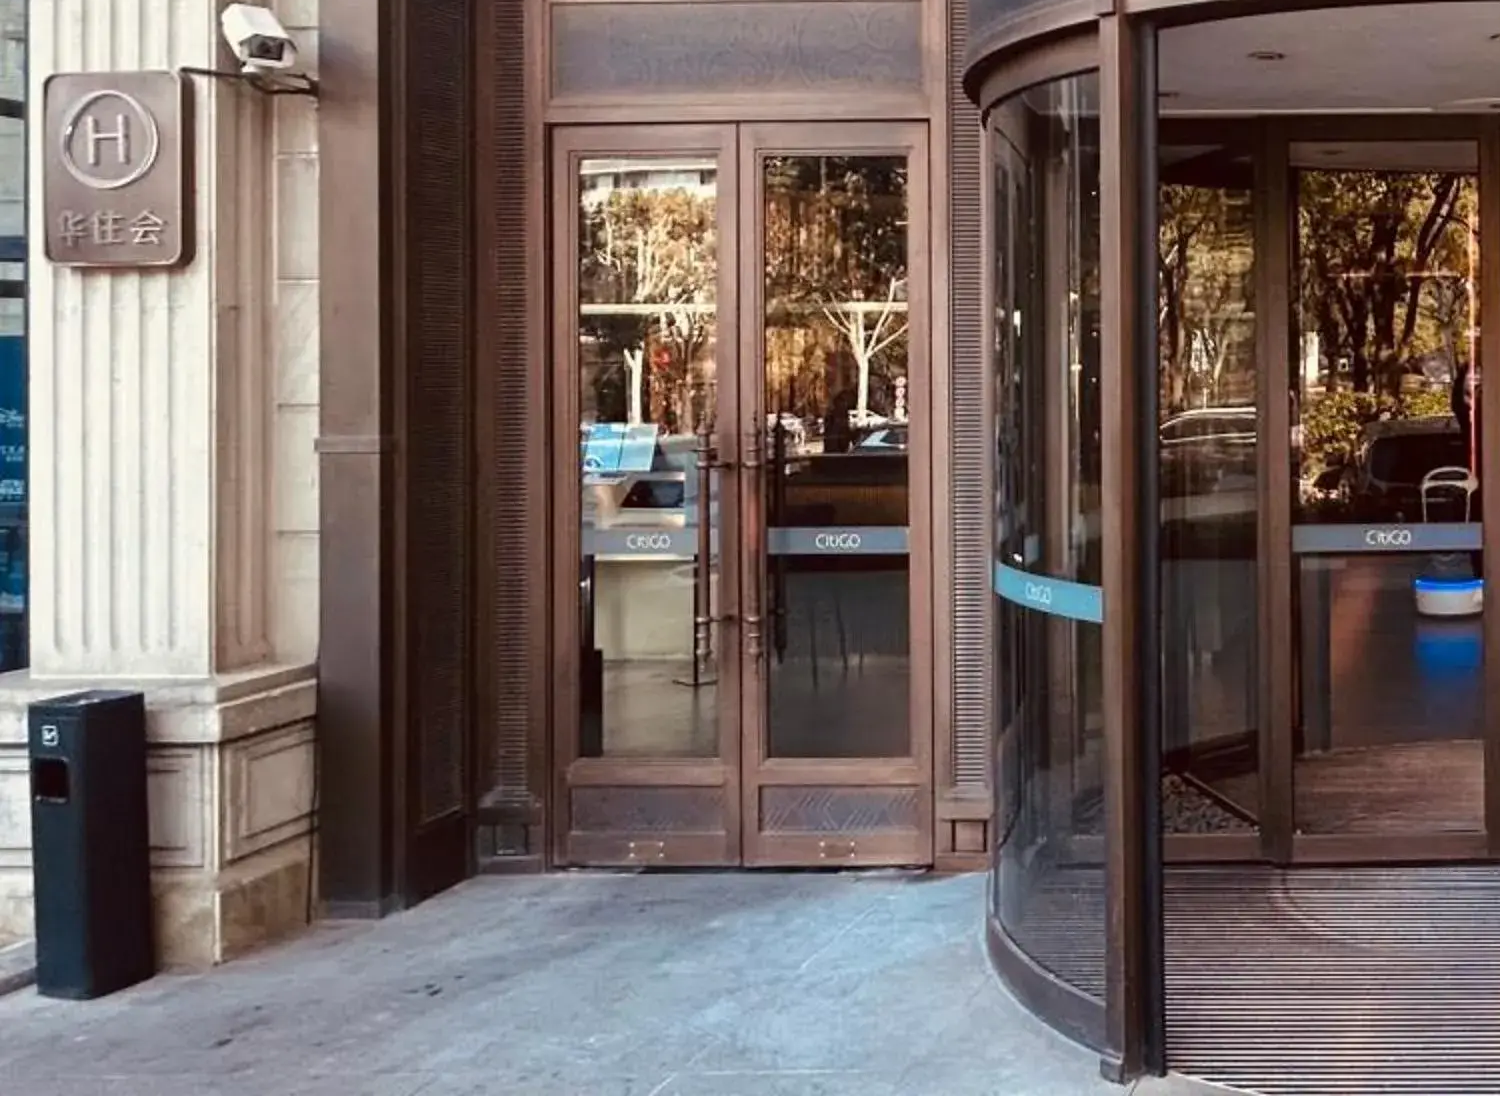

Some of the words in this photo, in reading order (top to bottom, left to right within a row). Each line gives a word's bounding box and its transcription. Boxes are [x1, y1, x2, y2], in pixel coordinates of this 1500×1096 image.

[85, 113, 129, 166] H
[57, 208, 167, 248] 华住会
